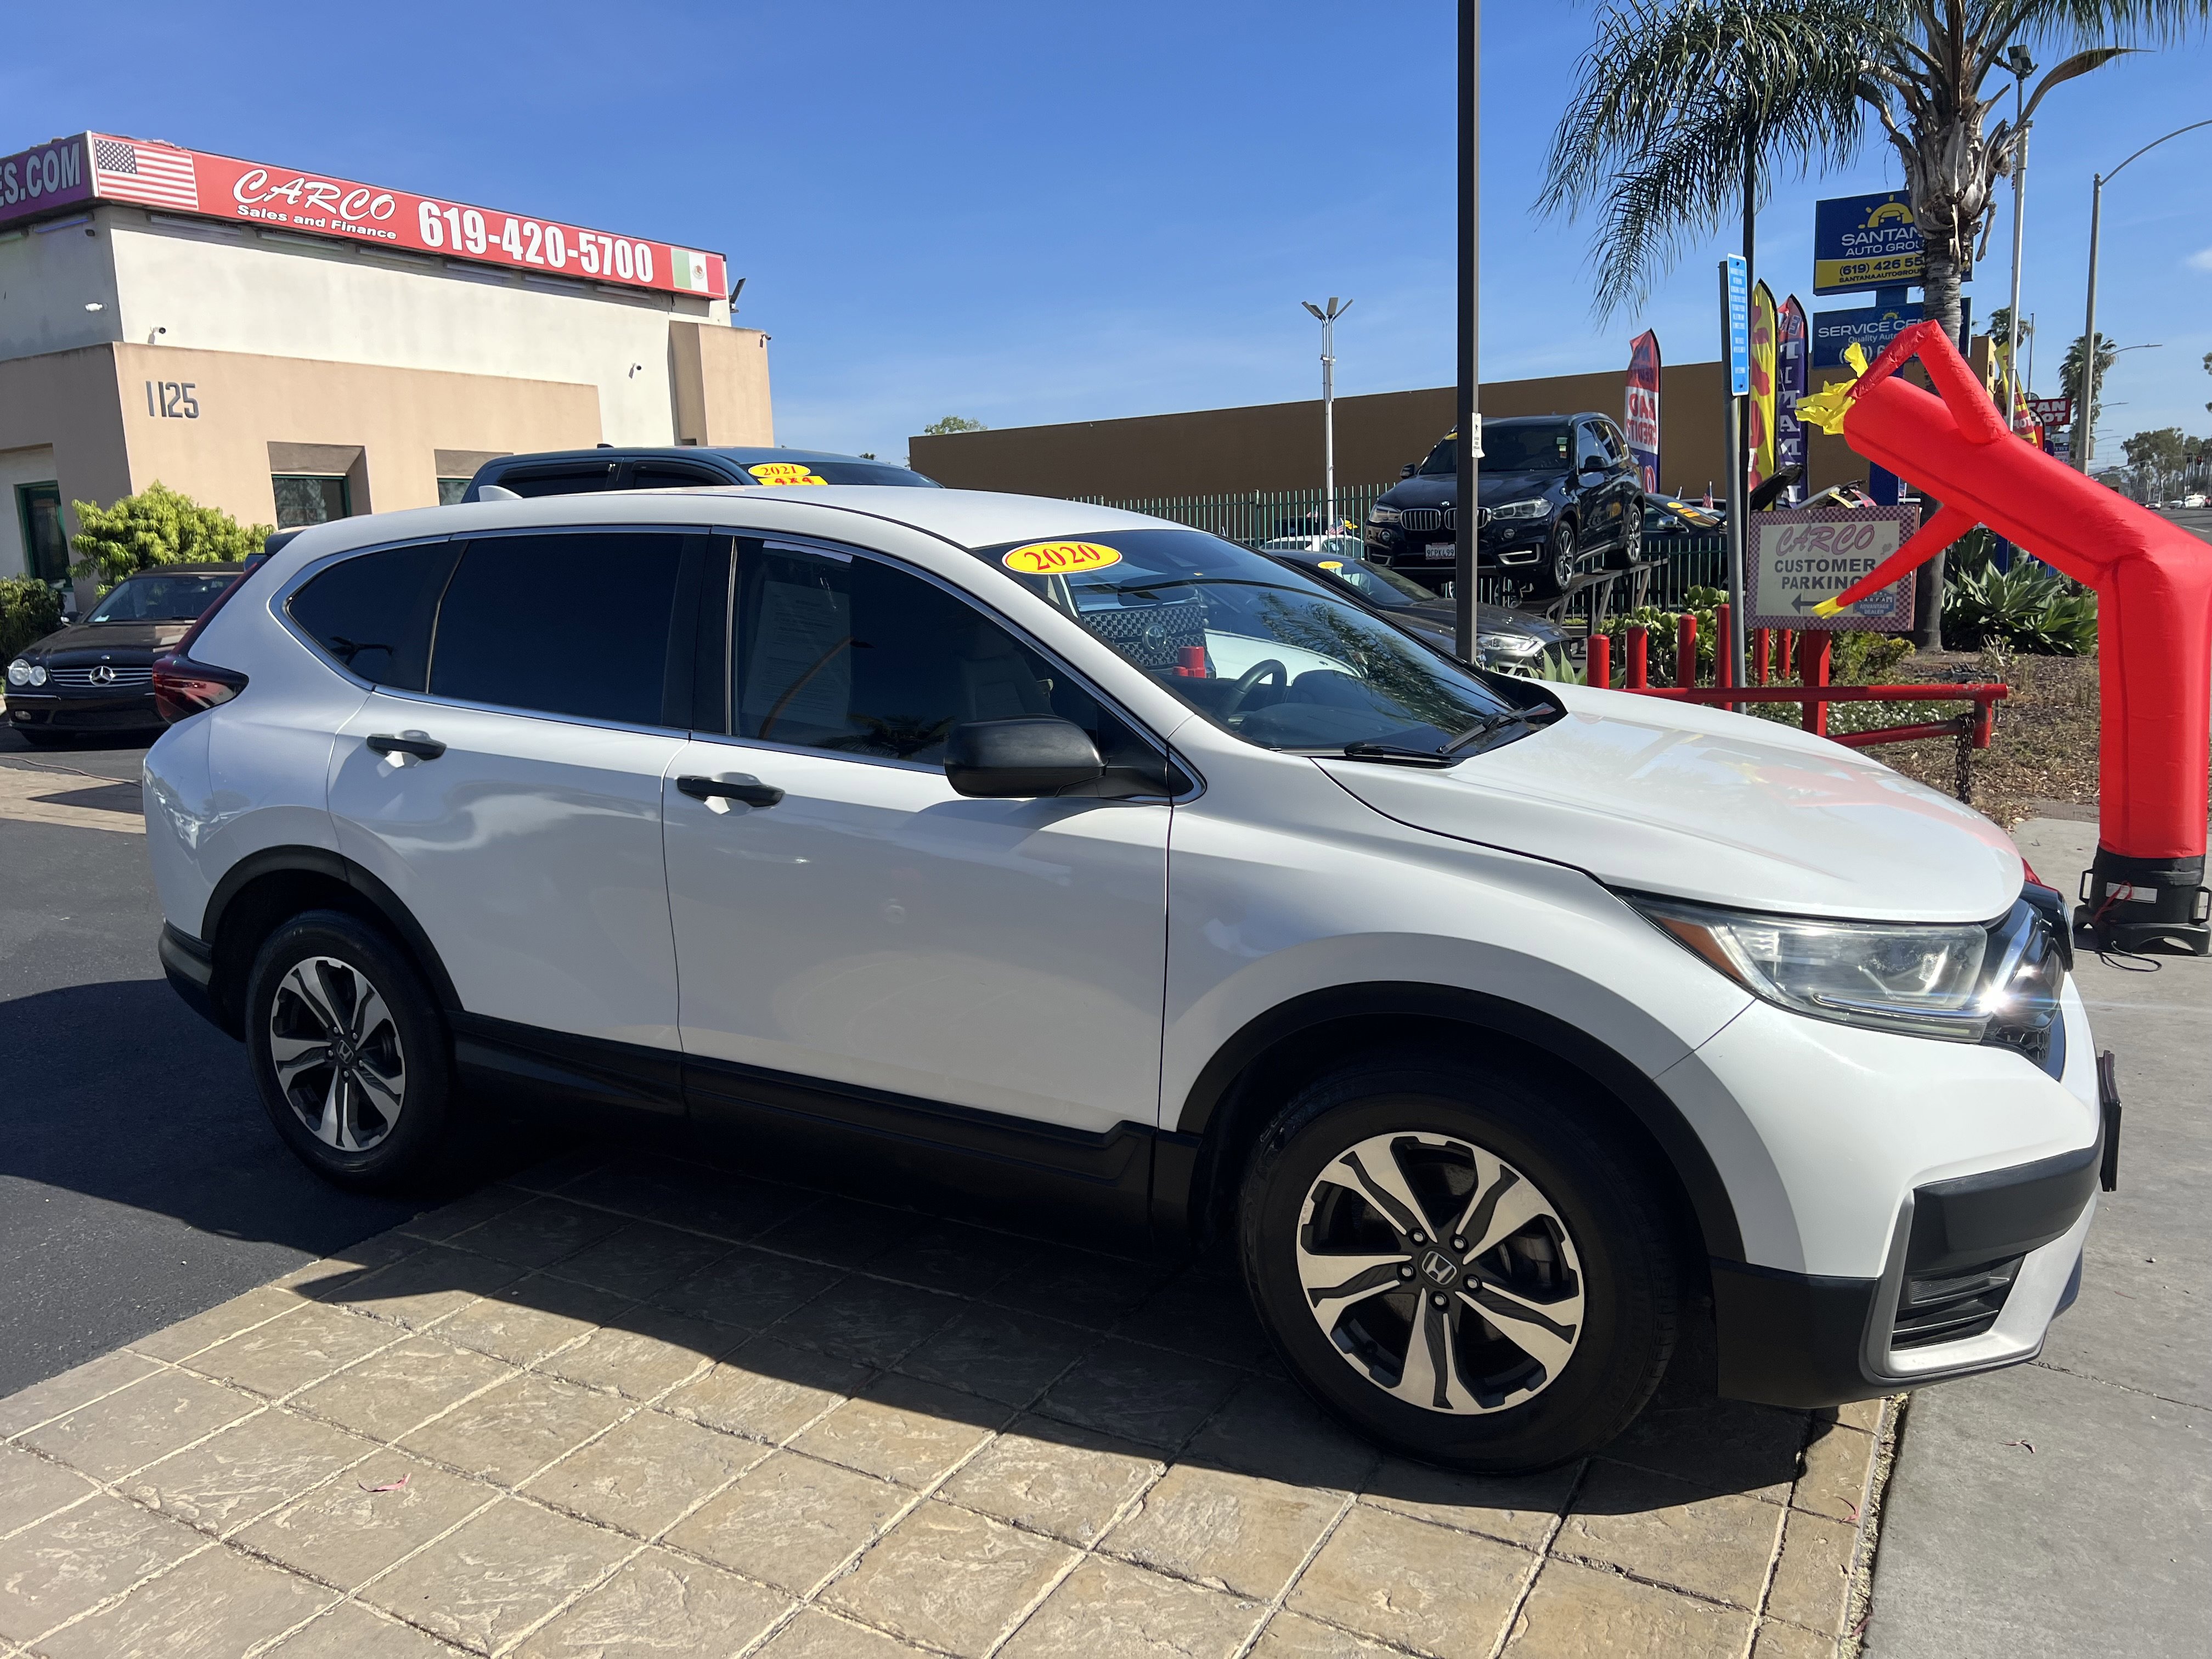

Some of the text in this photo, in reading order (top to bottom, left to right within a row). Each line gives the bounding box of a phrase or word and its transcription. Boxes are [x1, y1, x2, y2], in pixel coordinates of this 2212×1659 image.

[233, 168, 396, 221] CARCO
[236, 205, 397, 240] Sales and Finance
[417, 201, 654, 283] 619-420-5700
[1841, 226, 1923, 246] SANTAN
[1846, 240, 1925, 257] AUTO GROU
[1839, 257, 1923, 276] (619) 426 55
[1818, 321, 1890, 338] SERVICE
[1848, 335, 1877, 343] Quality
[145, 381, 199, 418] 1125
[760, 466, 797, 476] 2021
[1776, 524, 1875, 556] CARCO
[1024, 545, 1101, 570] 2020
[1775, 558, 1876, 573] CUSTOMER
